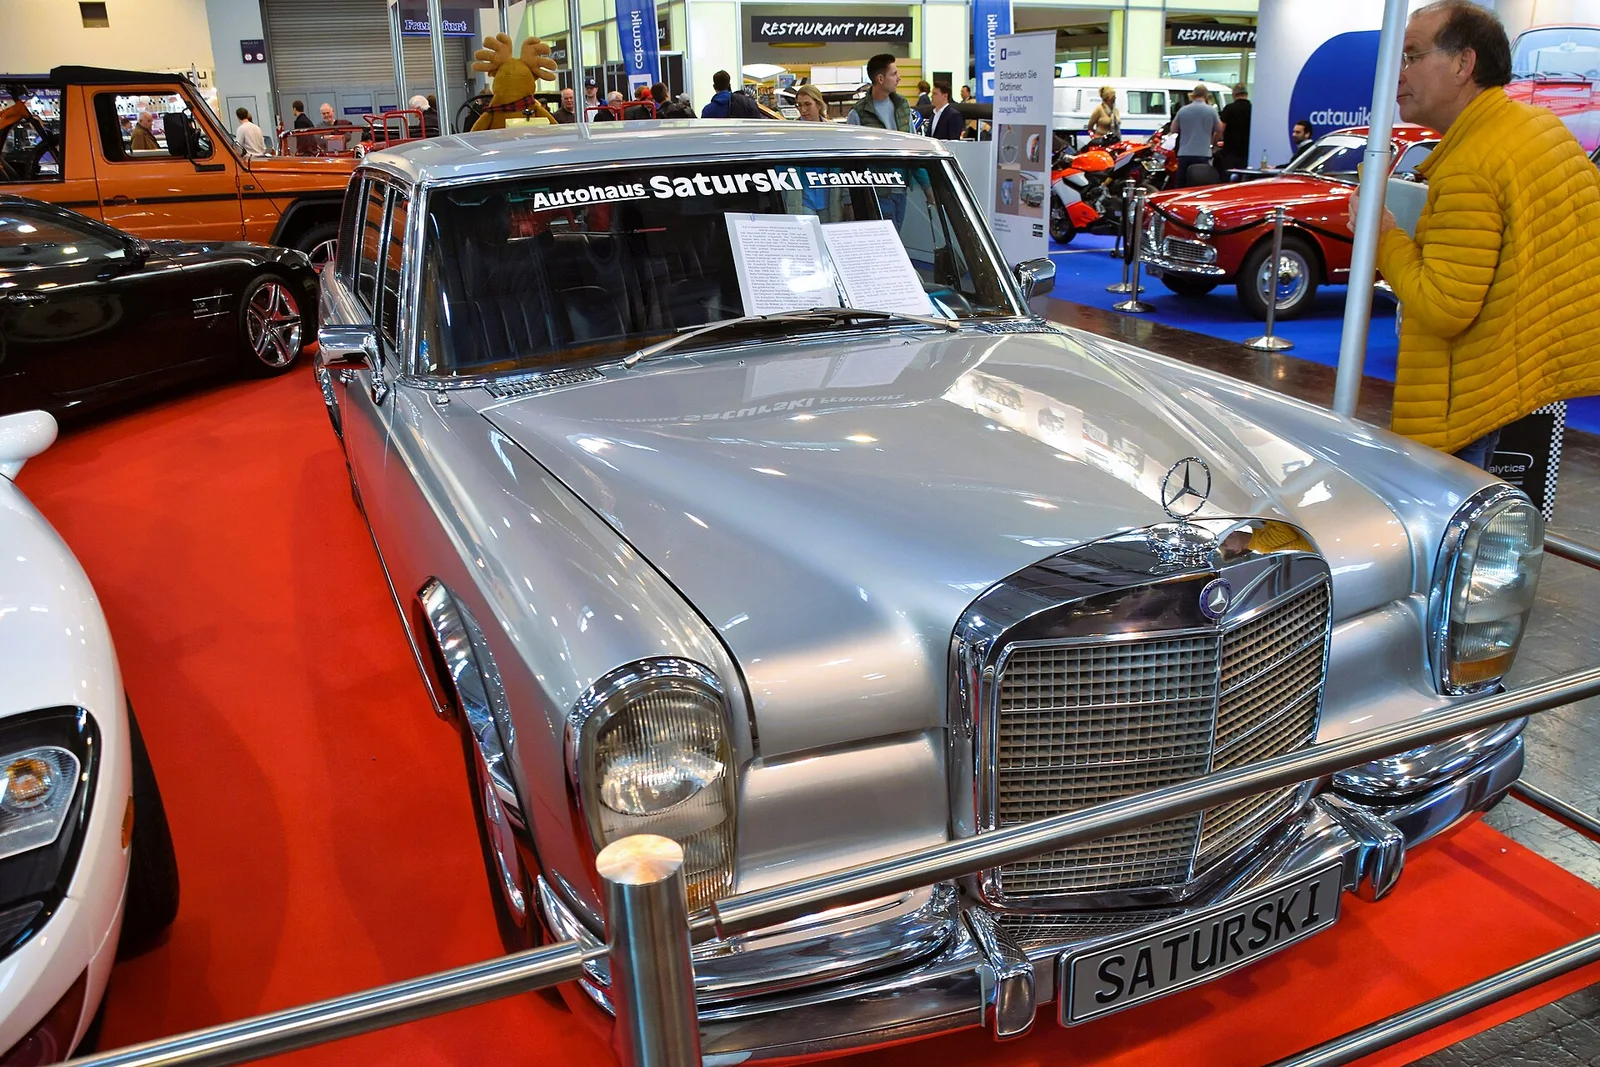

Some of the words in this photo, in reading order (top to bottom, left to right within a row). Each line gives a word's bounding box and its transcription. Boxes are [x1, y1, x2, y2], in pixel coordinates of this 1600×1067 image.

[404, 19, 468, 32] Franfurt
[760, 22, 854, 36] RESTAURANT
[855, 23, 905, 36] PIAZZA
[1177, 28, 1247, 42] RESTAURANT
[999, 70, 1027, 80] Entdecken
[1028, 70, 1038, 79] Sie
[1309, 106, 1372, 126] catawik
[533, 181, 645, 209] Autohaus
[649, 167, 804, 199] Saturski
[808, 169, 905, 187] Frankfurt
[1094, 880, 1322, 1004] SATURSKI
